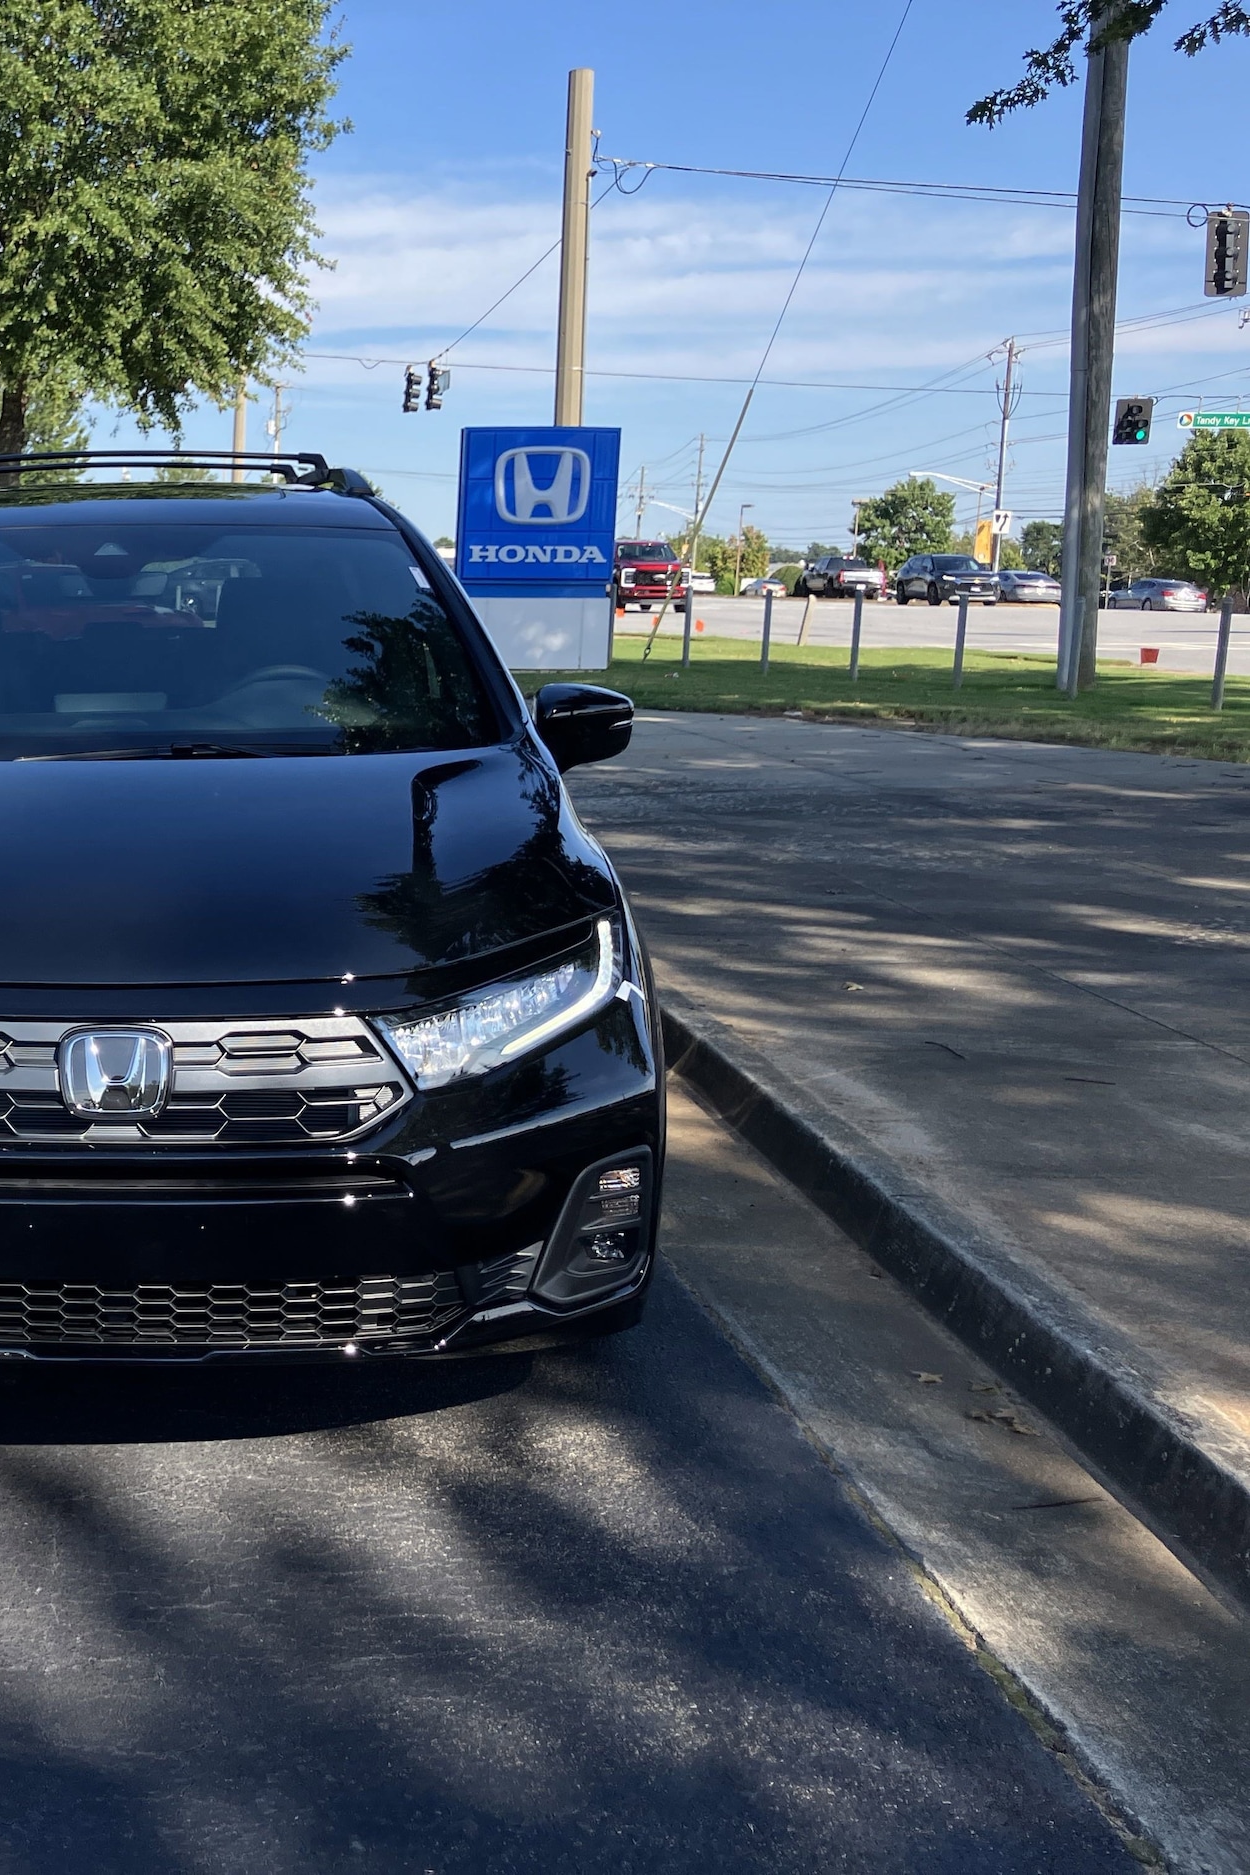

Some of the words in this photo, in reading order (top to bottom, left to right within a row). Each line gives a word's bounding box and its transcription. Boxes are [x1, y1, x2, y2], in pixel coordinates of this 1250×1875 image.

[1196, 416, 1221, 426] Tandy
[1224, 416, 1240, 426] Key
[469, 545, 607, 564] HONDA
